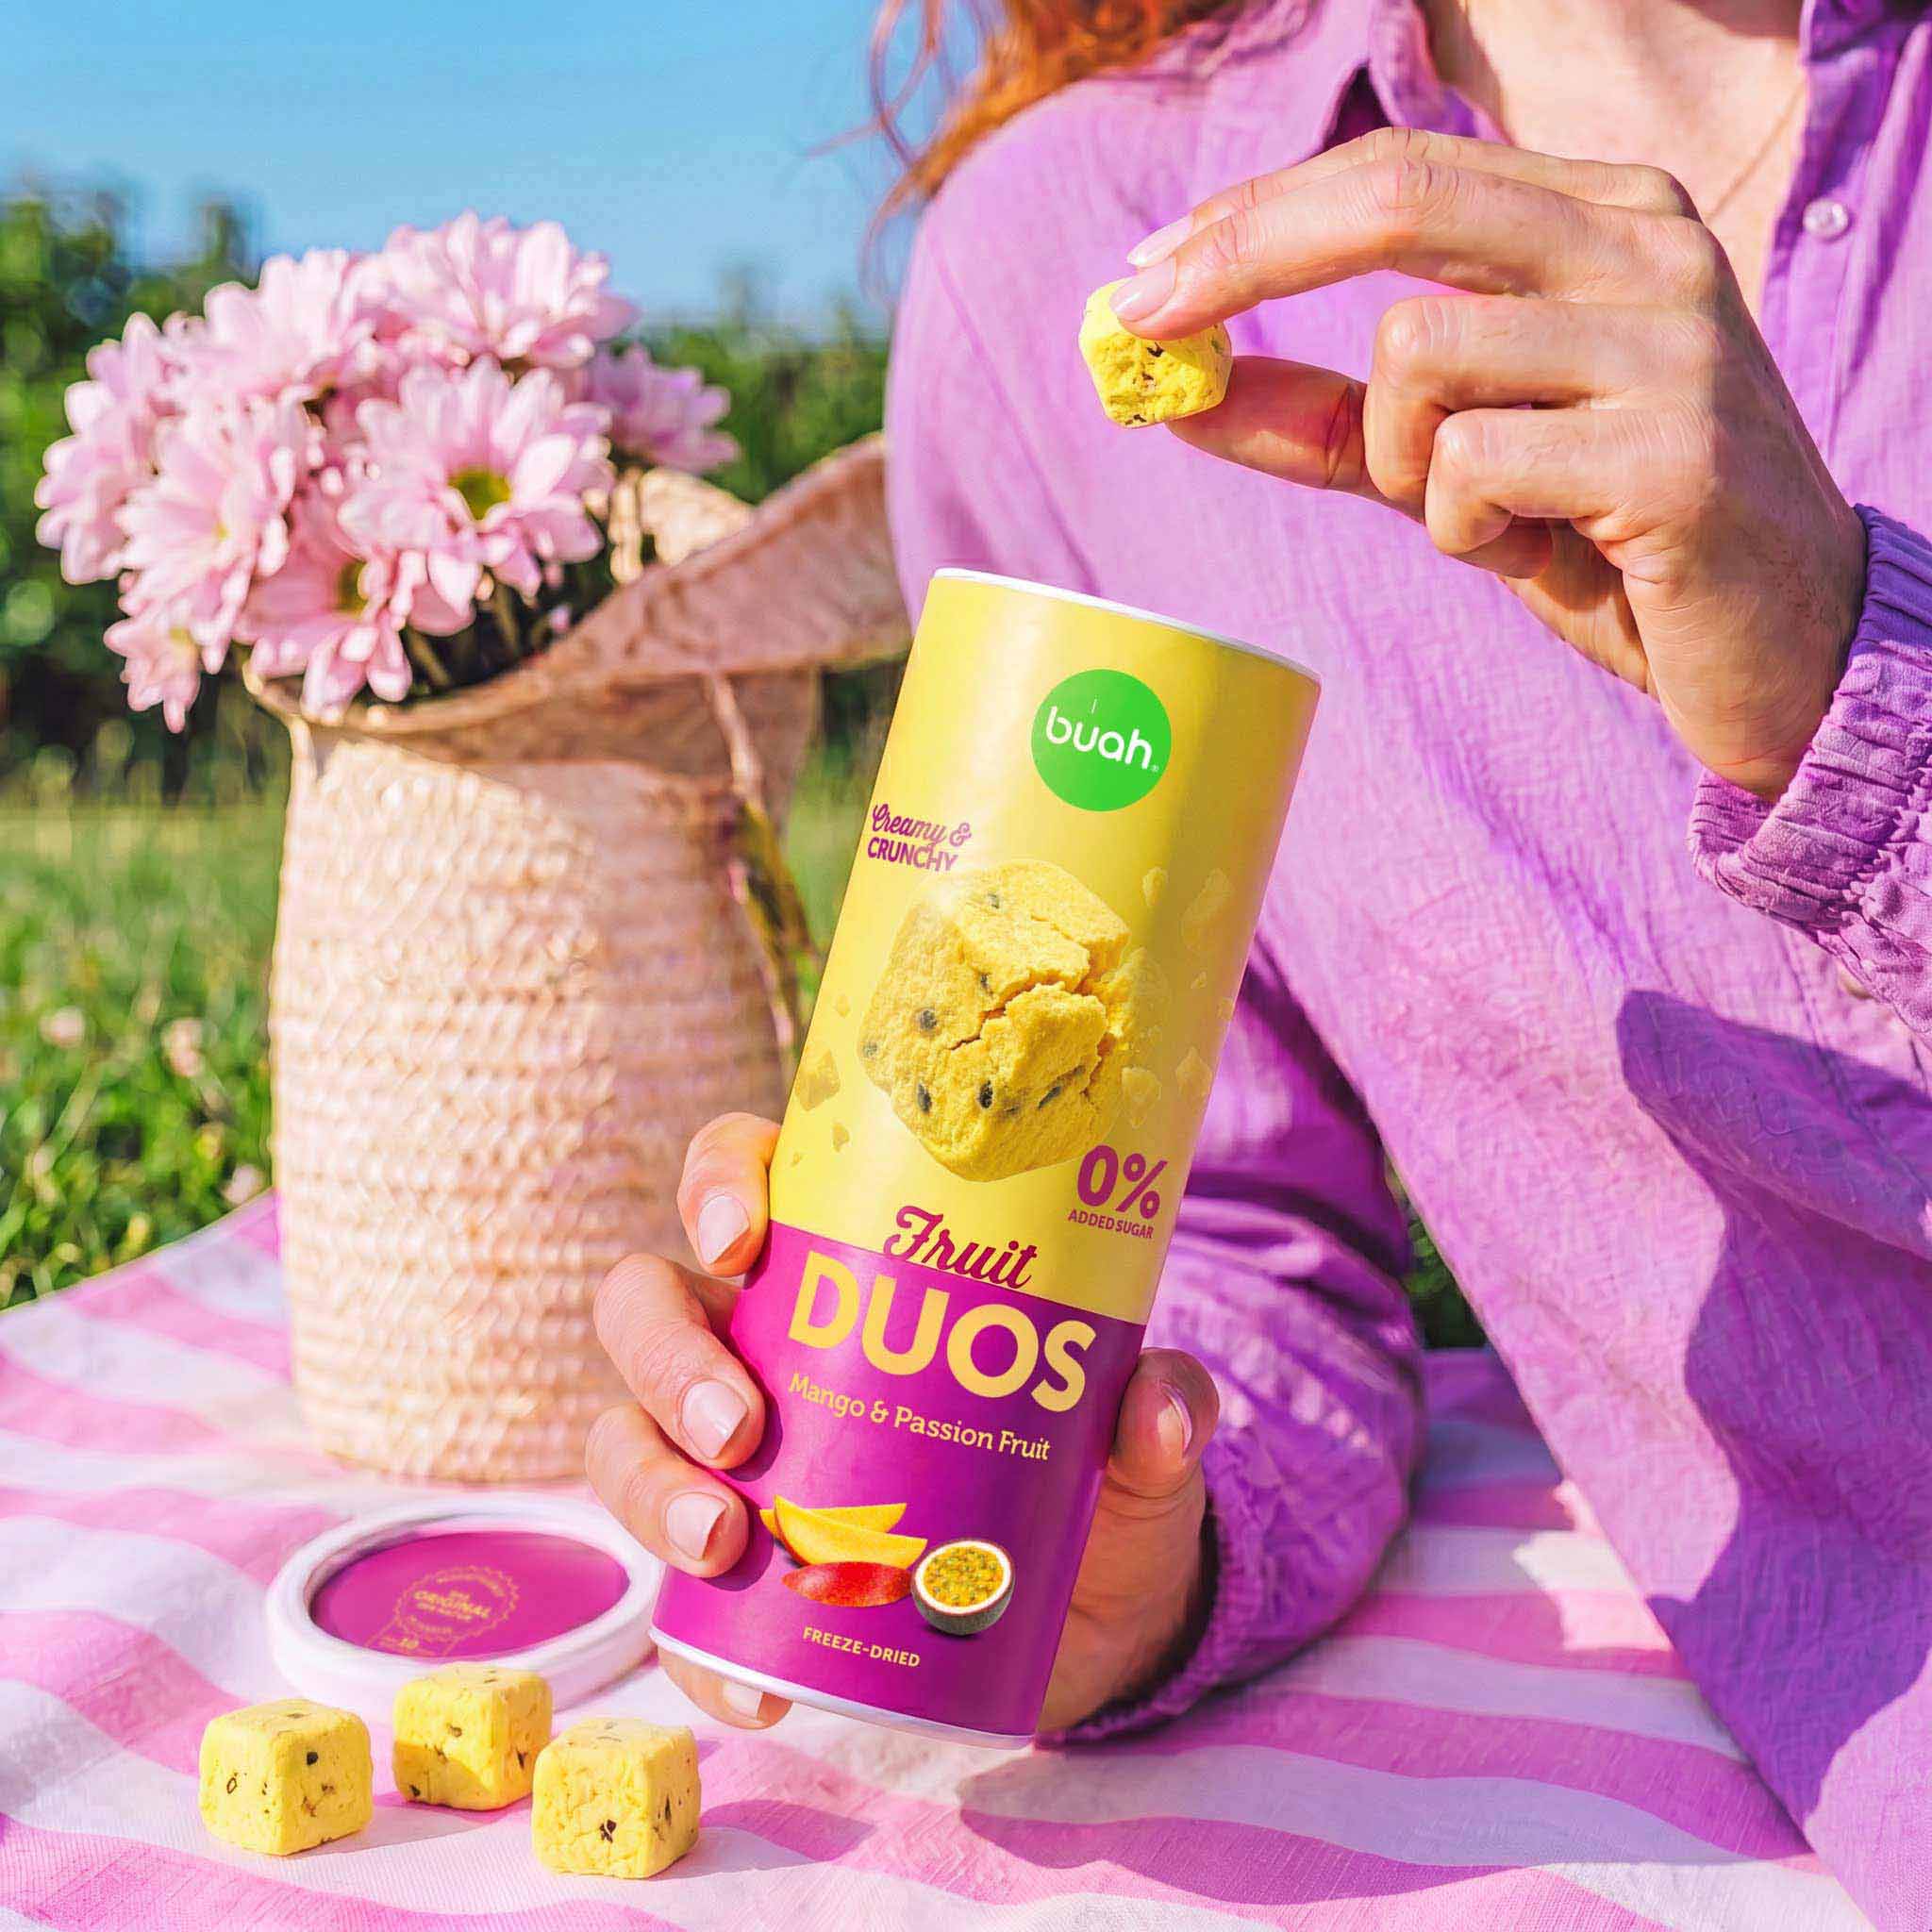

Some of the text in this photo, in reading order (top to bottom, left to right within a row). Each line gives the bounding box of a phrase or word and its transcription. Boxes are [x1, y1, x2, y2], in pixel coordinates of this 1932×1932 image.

[873, 803, 973, 847] Creamy &
[867, 836, 958, 872] CRUNCHY
[1076, 1144, 1169, 1220] 0%
[1068, 1208, 1155, 1240] ADDED SUGAR
[883, 1205, 1038, 1290] Fruit
[788, 1249, 1097, 1413] DUOS
[789, 1373, 1051, 1462] Mango & Passion Fruit
[413, 1590, 492, 1620] ORIGINAL
[803, 1625, 922, 1668] FREEZE-DRIED
